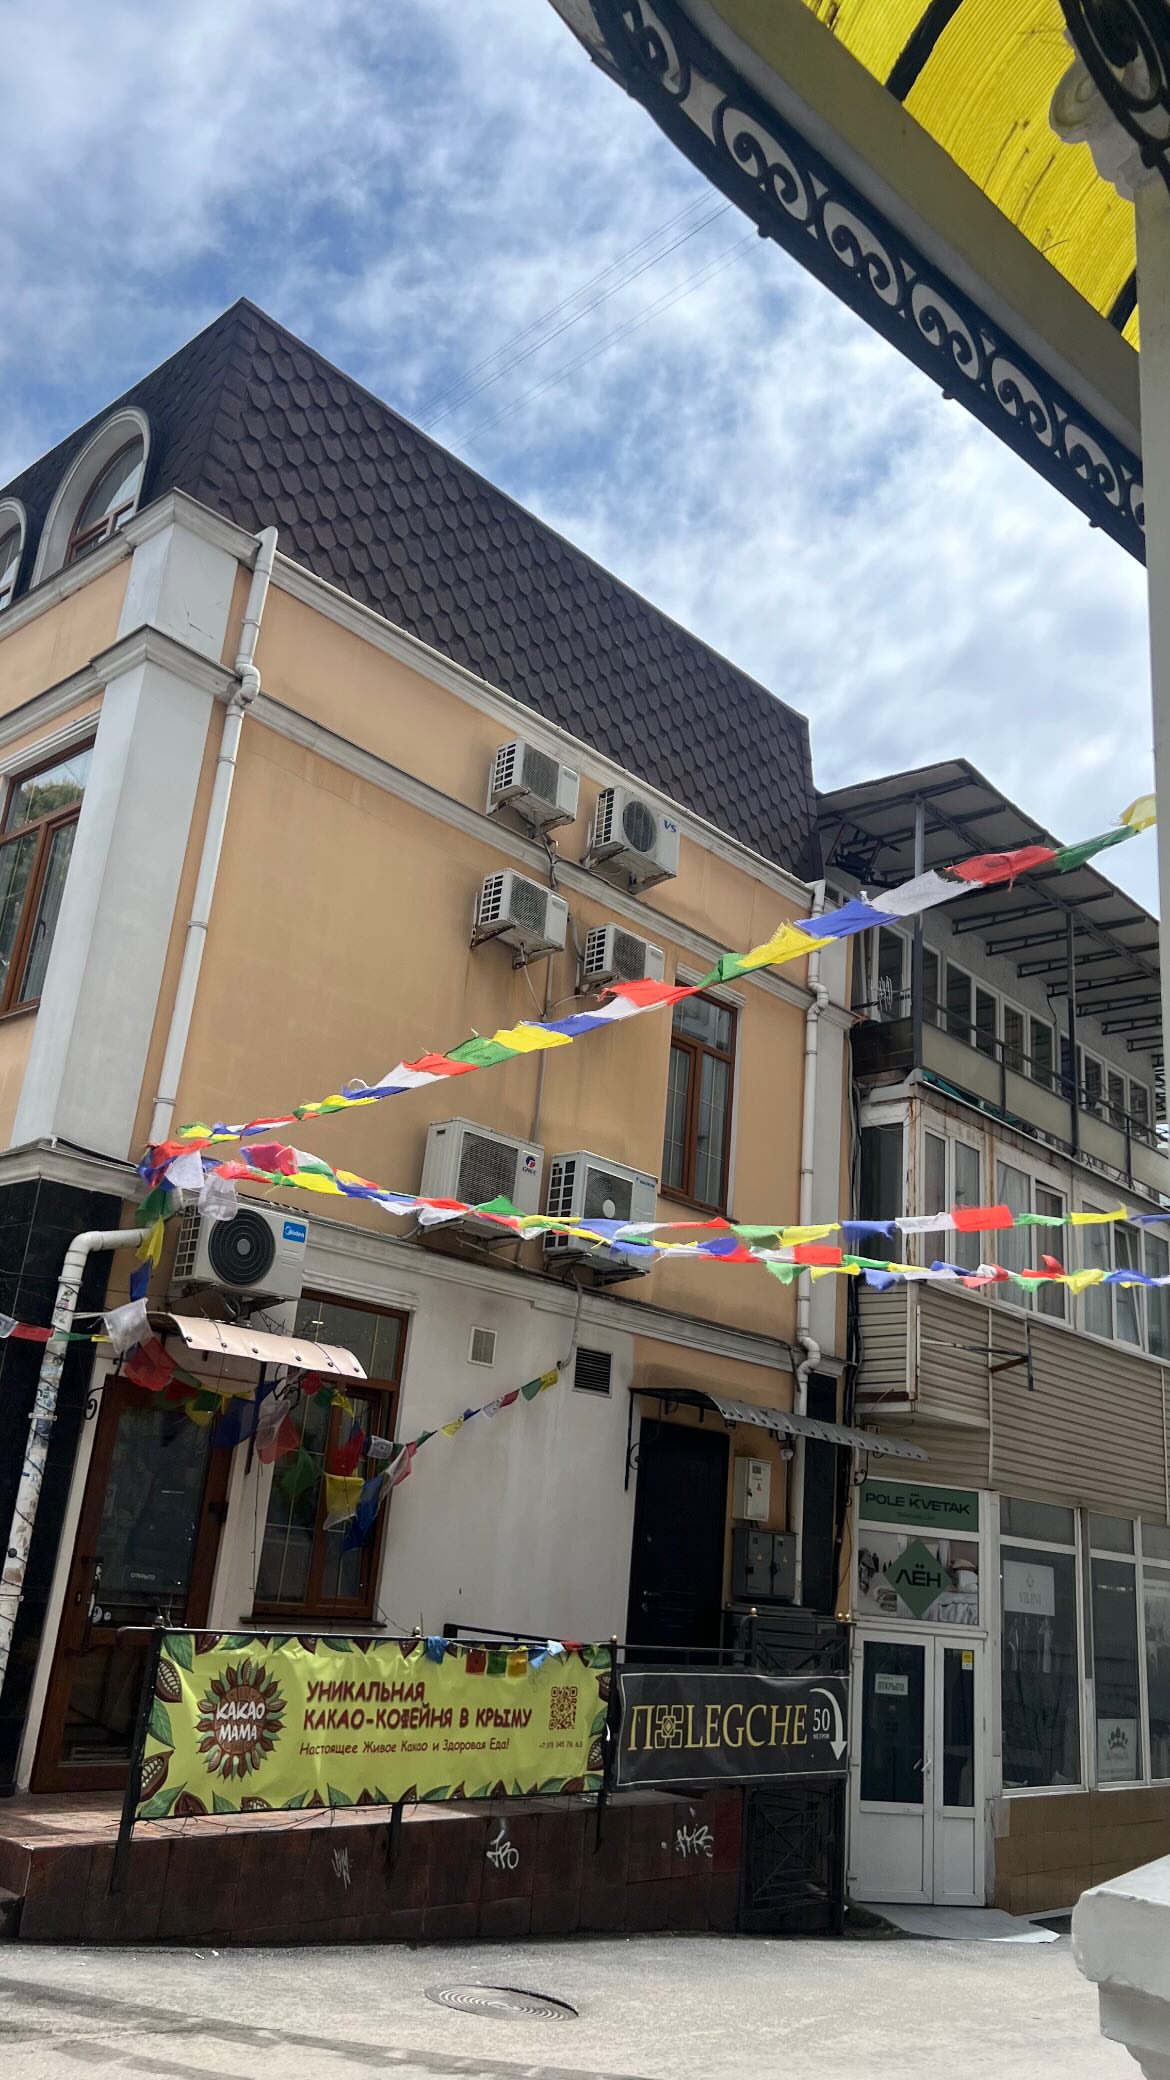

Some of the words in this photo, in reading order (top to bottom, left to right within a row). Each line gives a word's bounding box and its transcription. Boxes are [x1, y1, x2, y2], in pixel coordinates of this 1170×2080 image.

[865, 1492, 904, 1507] POLE
[895, 1563, 942, 1588] ЛЁН
[306, 1681, 425, 1703] УНИКАЛЬНАЯ
[216, 1701, 266, 1720] КАКАО
[303, 1702, 452, 1730] КАКАО-КОФЕЙНЯ
[459, 1708, 470, 1728] В
[475, 1708, 533, 1729] КРЫМУ
[812, 1708, 831, 1732] 50
[219, 1723, 257, 1742] МАМА
[299, 1742, 358, 1756] Настоящее
[362, 1741, 397, 1753] Живое
[401, 1740, 429, 1752] Какао
[432, 1742, 440, 1751] и
[442, 1739, 486, 1754] Здоровая
[489, 1738, 511, 1750] Еда!
